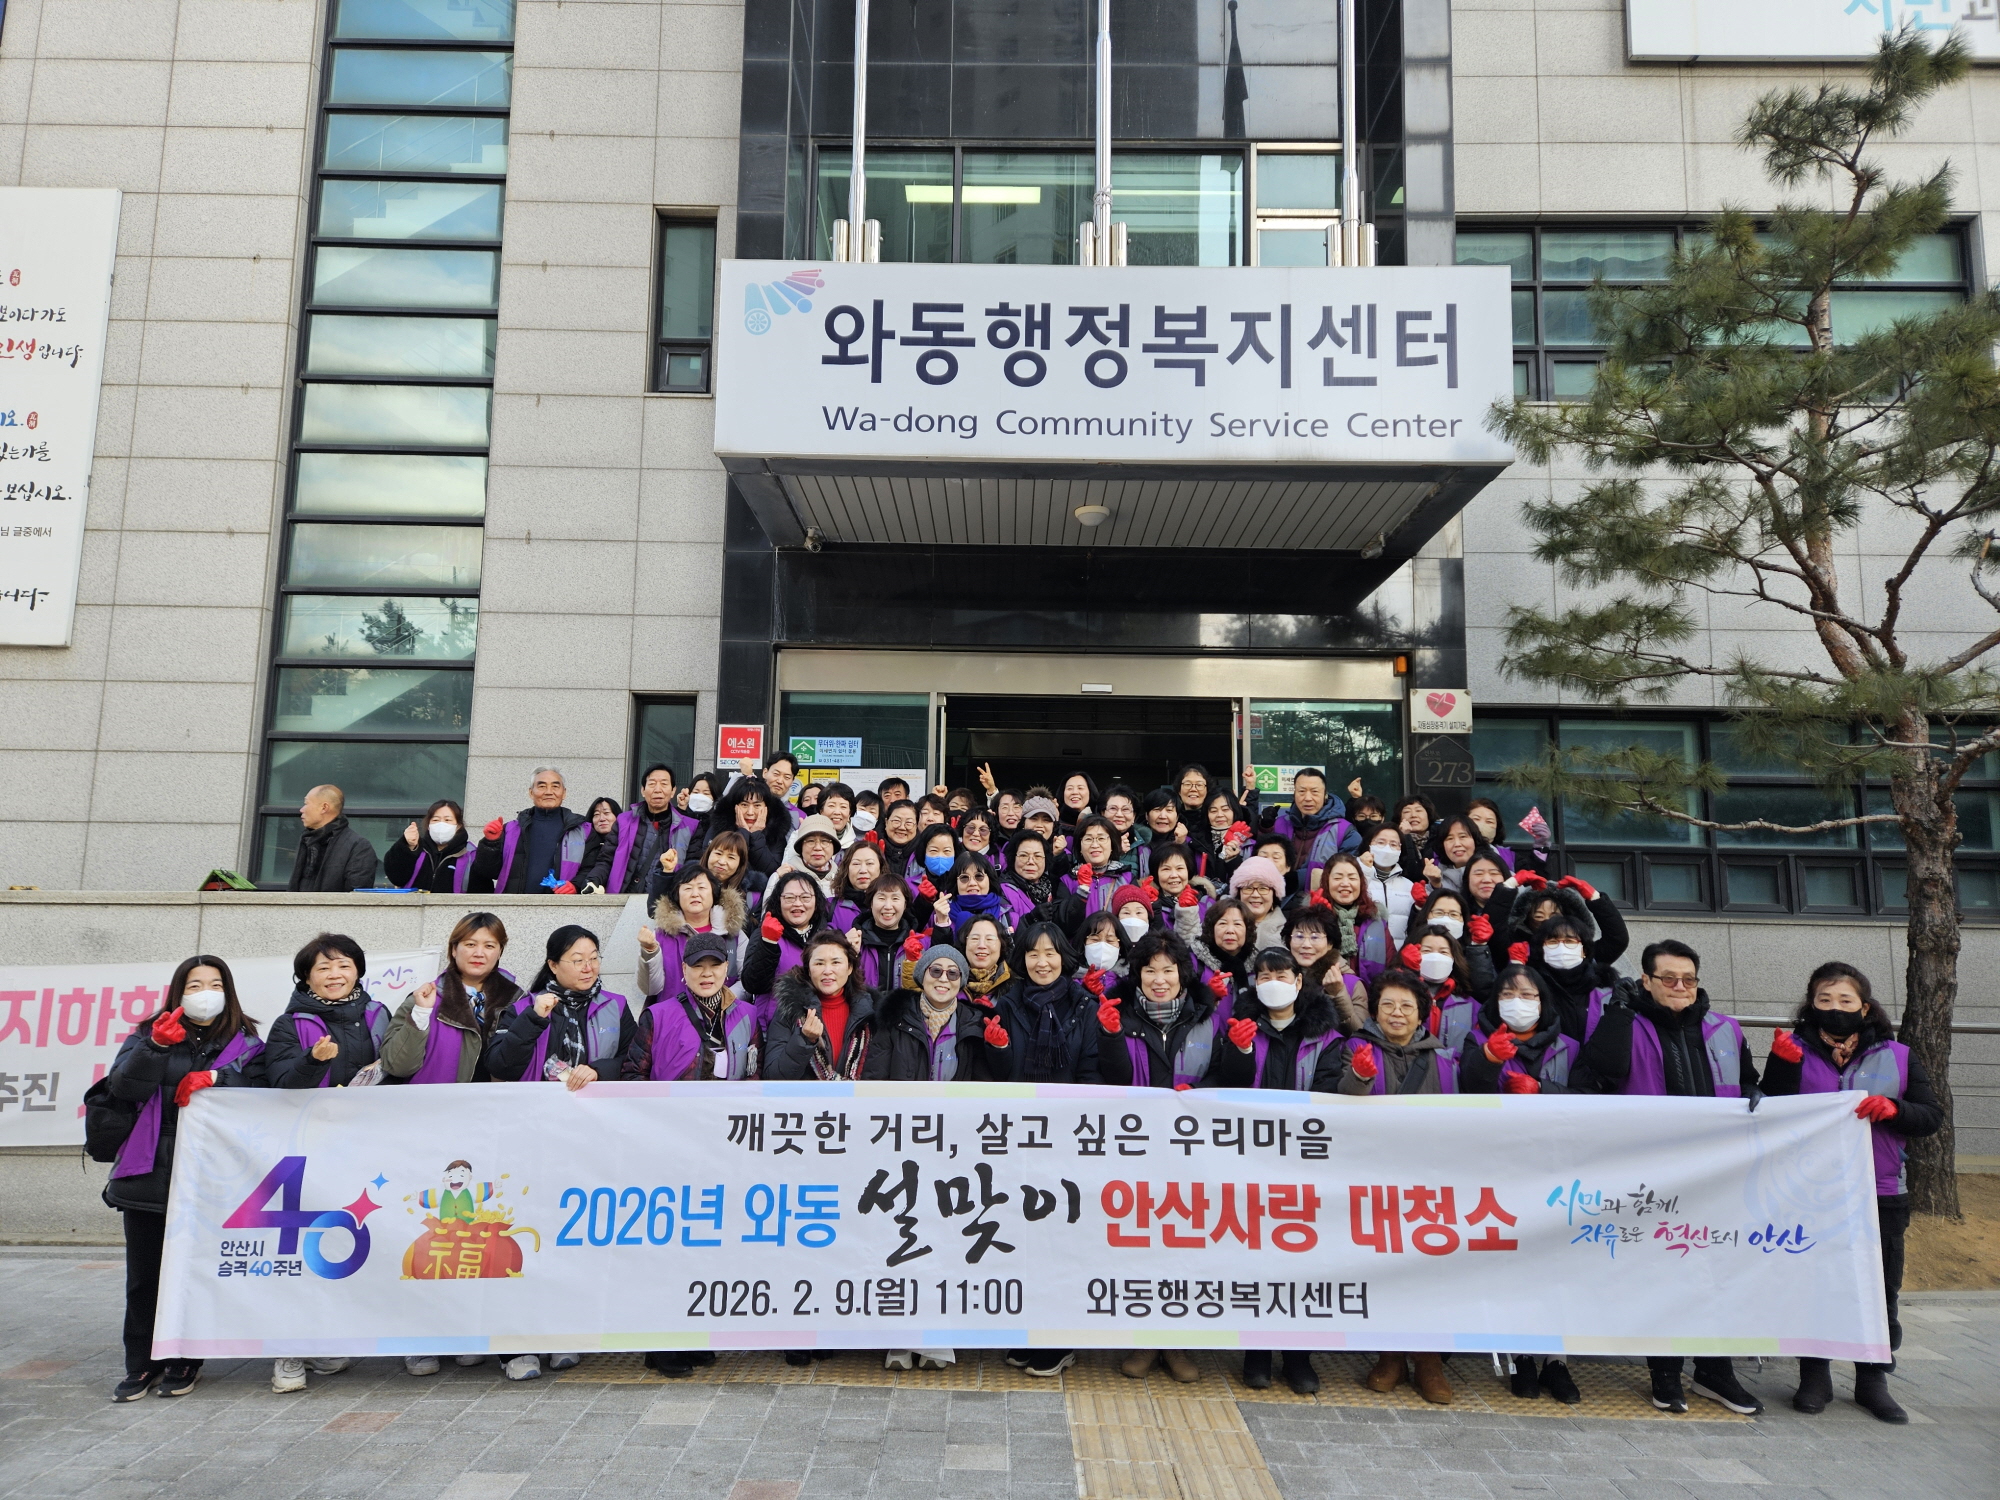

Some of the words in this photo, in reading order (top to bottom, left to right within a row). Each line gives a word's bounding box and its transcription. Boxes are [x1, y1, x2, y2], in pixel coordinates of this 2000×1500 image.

[822, 299, 1458, 388] 와동행정복지센터
[822, 406, 977, 439] Wa-dong
[997, 410, 1193, 443] Community
[1210, 412, 1328, 437] Service
[1347, 413, 1462, 437] Center
[13, 526, 52, 537] 글중에서
[727, 738, 755, 749] 에스원
[1428, 761, 1473, 784] 273
[727, 1110, 851, 1155] 깨끗한
[871, 1114, 957, 1159] 거리,
[976, 1113, 1052, 1155] 살고
[1073, 1114, 1149, 1156] 싶은
[1170, 1116, 1332, 1159] 우리마을
[556, 1184, 724, 1247] 2026년
[741, 1184, 840, 1248] 와동
[858, 1160, 1080, 1267] 설맞이
[1101, 1180, 1321, 1253] 안산사랑
[1349, 1185, 1518, 1256] 대청소
[1547, 1179, 1626, 1225] 시민과
[220, 1240, 265, 1257] 안산시
[1571, 1223, 1644, 1259] 자유로운
[1654, 1221, 1738, 1258] 혁신도시
[1748, 1223, 1816, 1253] 안산
[217, 1260, 303, 1277] 승격40주년
[687, 1280, 777, 1317] 2026.
[794, 1280, 819, 1315] 2.
[936, 1279, 1022, 1315] 11:00
[1087, 1278, 1368, 1318] 와동행정복지센터
